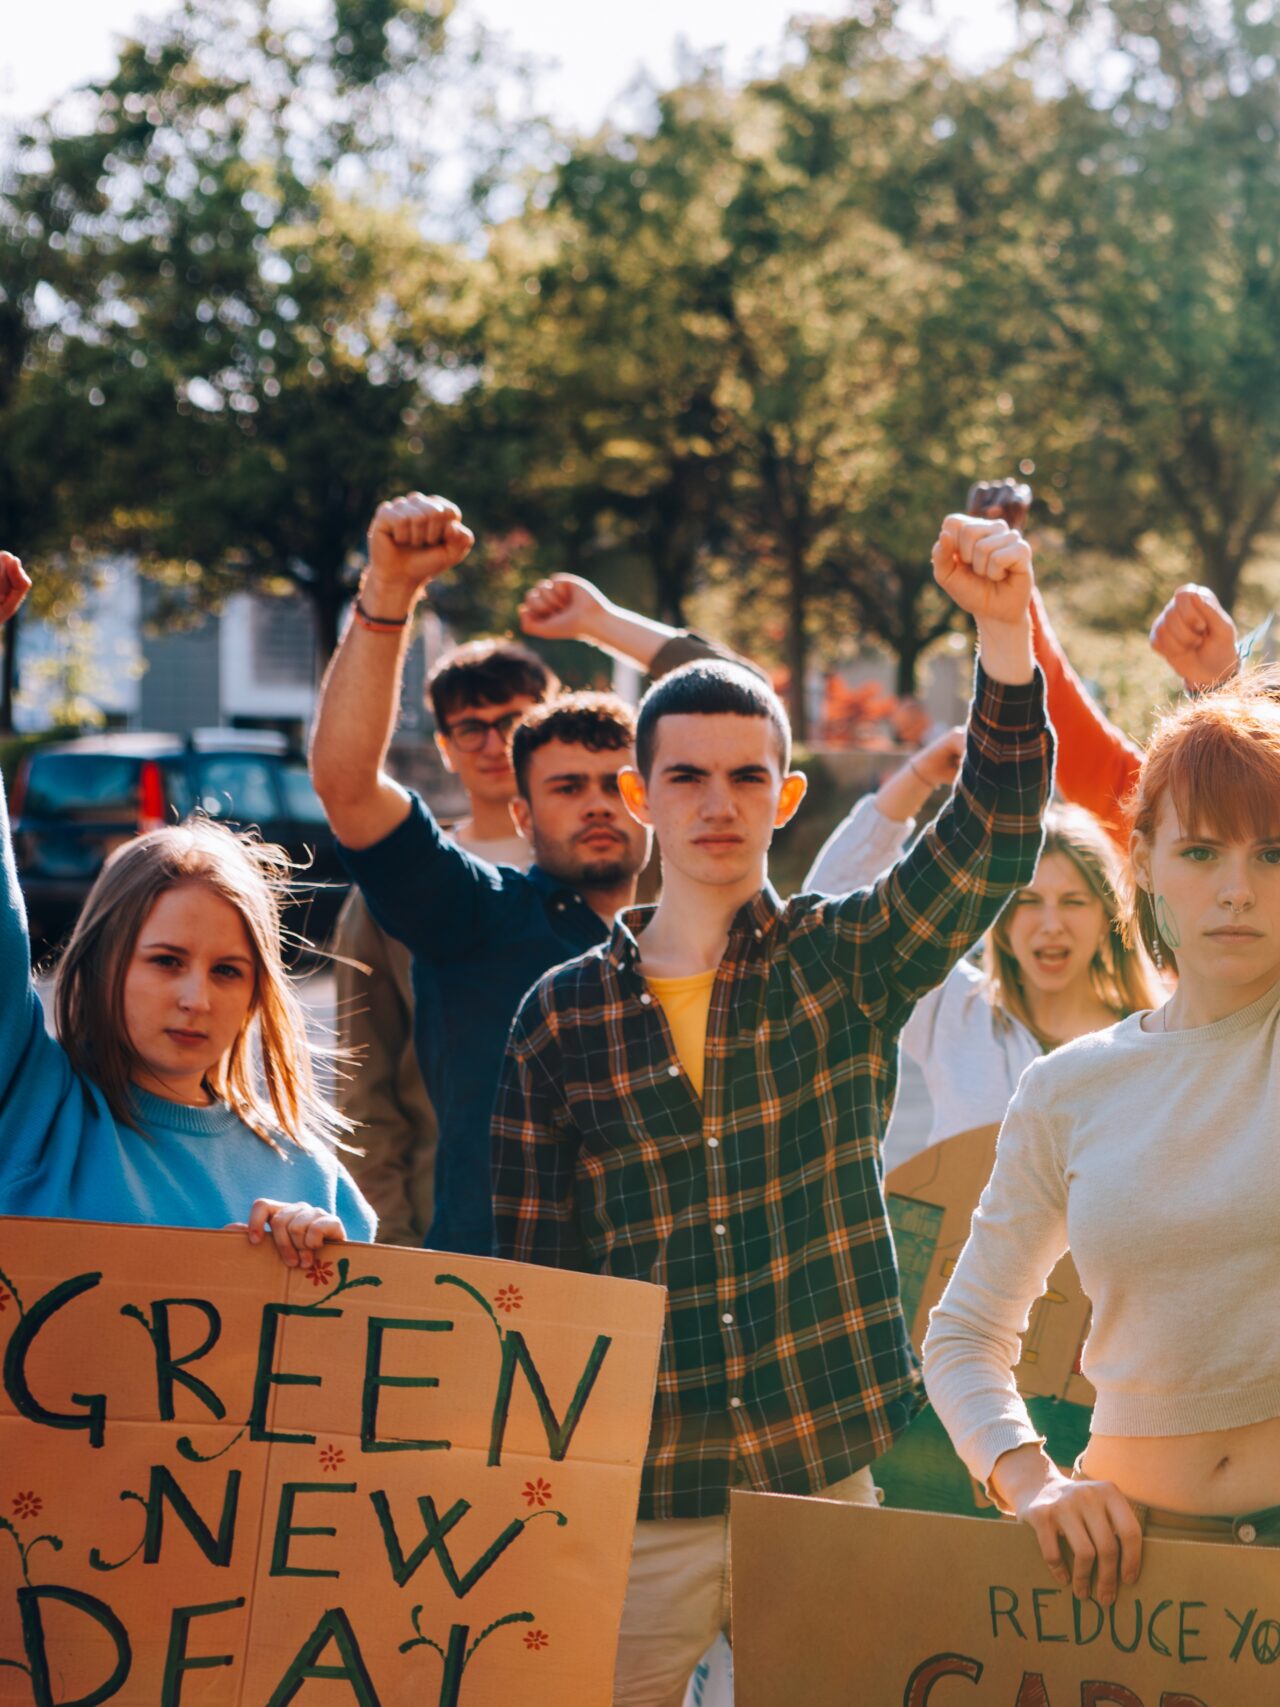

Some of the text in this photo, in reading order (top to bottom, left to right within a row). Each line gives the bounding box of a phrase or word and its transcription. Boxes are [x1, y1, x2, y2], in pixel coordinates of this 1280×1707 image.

[4, 1272, 612, 1467] GREEN
[140, 1465, 526, 1599] NEW
[988, 1584, 1208, 1665] REDUCE
